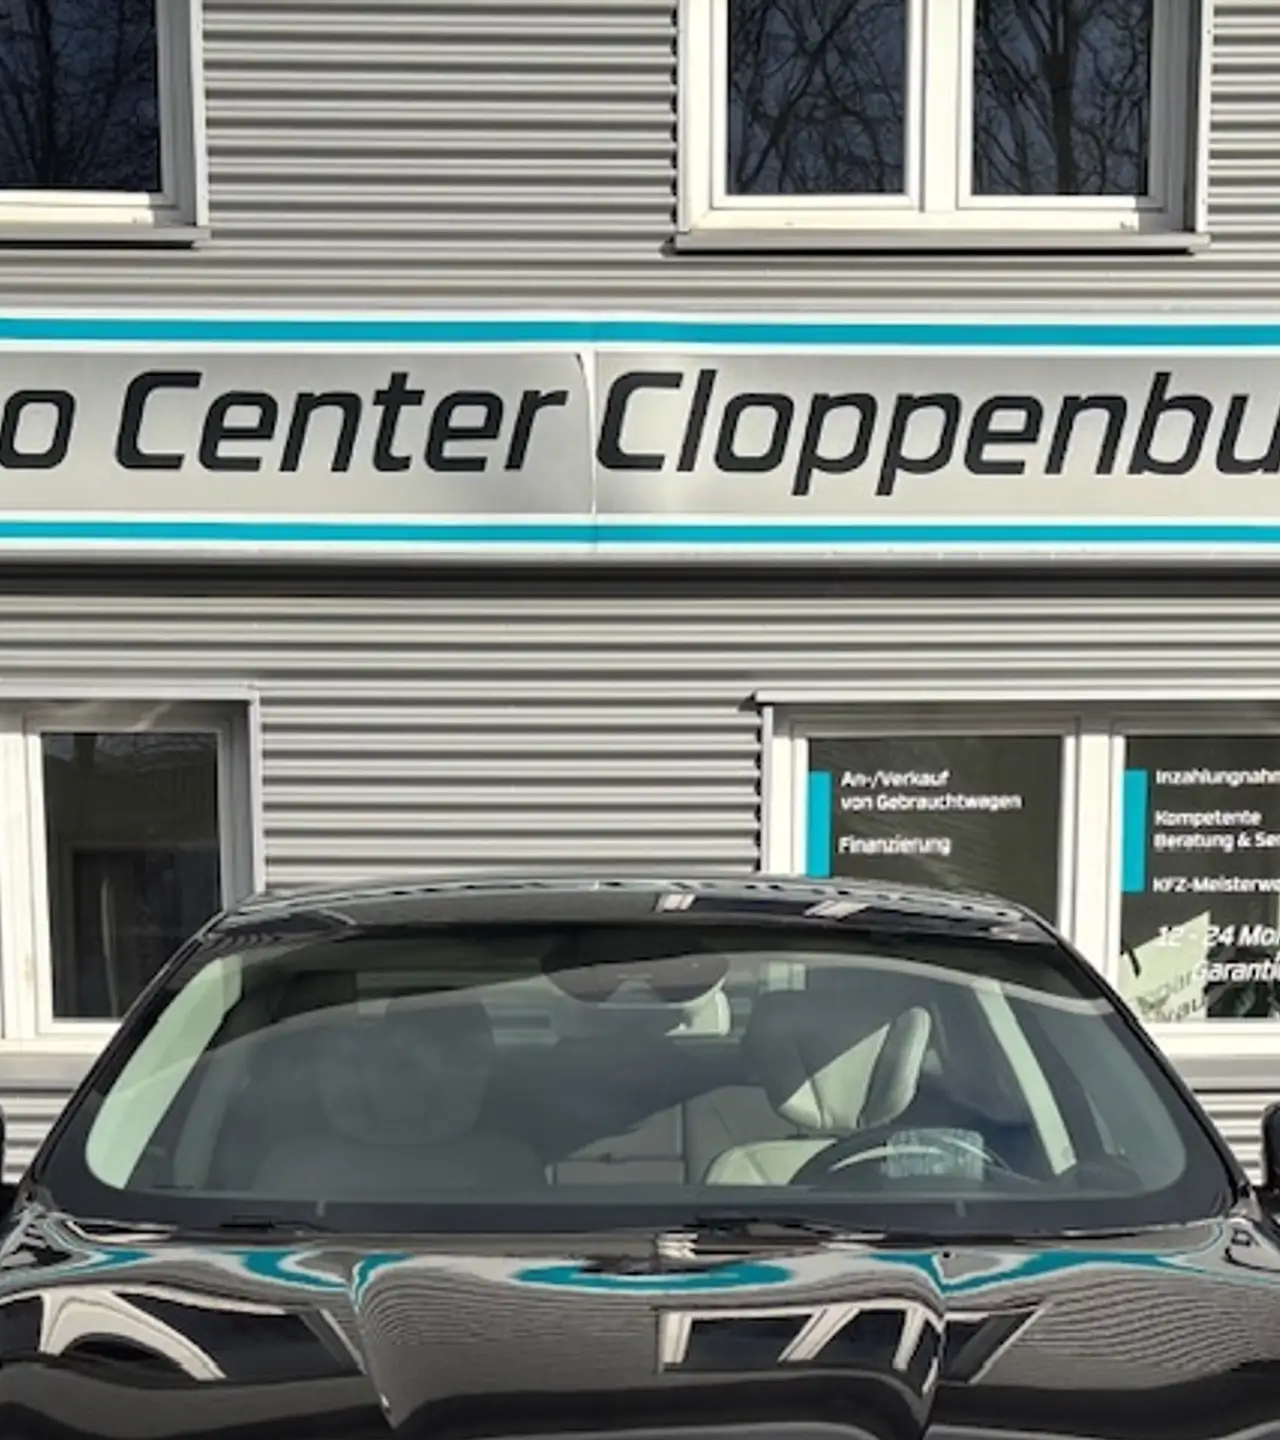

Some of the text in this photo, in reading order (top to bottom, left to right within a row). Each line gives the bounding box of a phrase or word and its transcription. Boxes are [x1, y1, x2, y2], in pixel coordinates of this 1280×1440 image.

[113, 369, 568, 474] Center
[840, 770, 951, 790] An-/Verkauf
[840, 793, 1023, 812] von Gebrauchtwagen
[1154, 809, 1263, 828] Kompetente
[838, 835, 953, 857] Finanzierung
[1152, 833, 1235, 853] Beratung
[1237, 834, 1252, 848] &
[1202, 924, 1236, 947] 24
